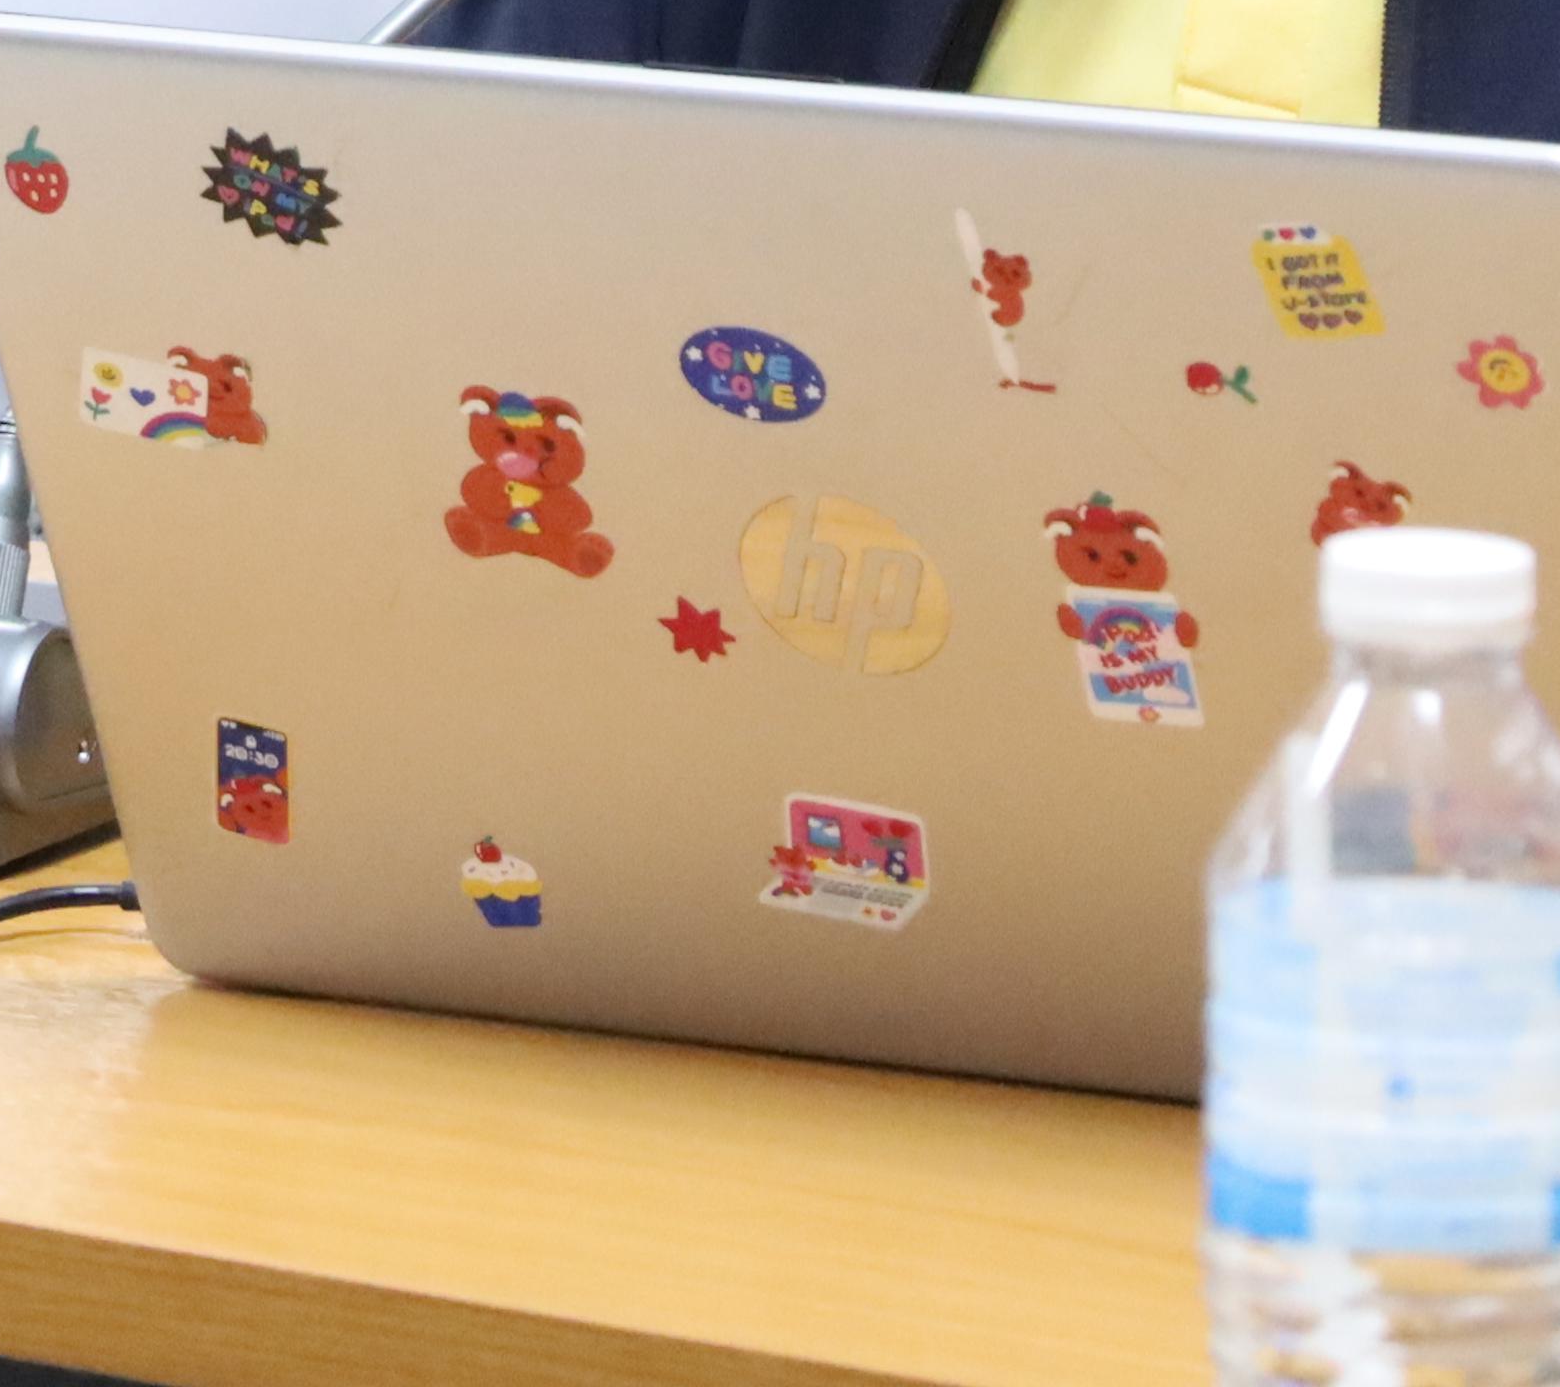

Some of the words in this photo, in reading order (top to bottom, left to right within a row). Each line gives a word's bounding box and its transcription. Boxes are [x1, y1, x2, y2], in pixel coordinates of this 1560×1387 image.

[1281, 272, 1344, 290] FROM
[706, 340, 793, 384] GIVE
[711, 374, 799, 411] LOVE
[775, 495, 924, 674] hp
[1104, 665, 1174, 694] BUDDY
